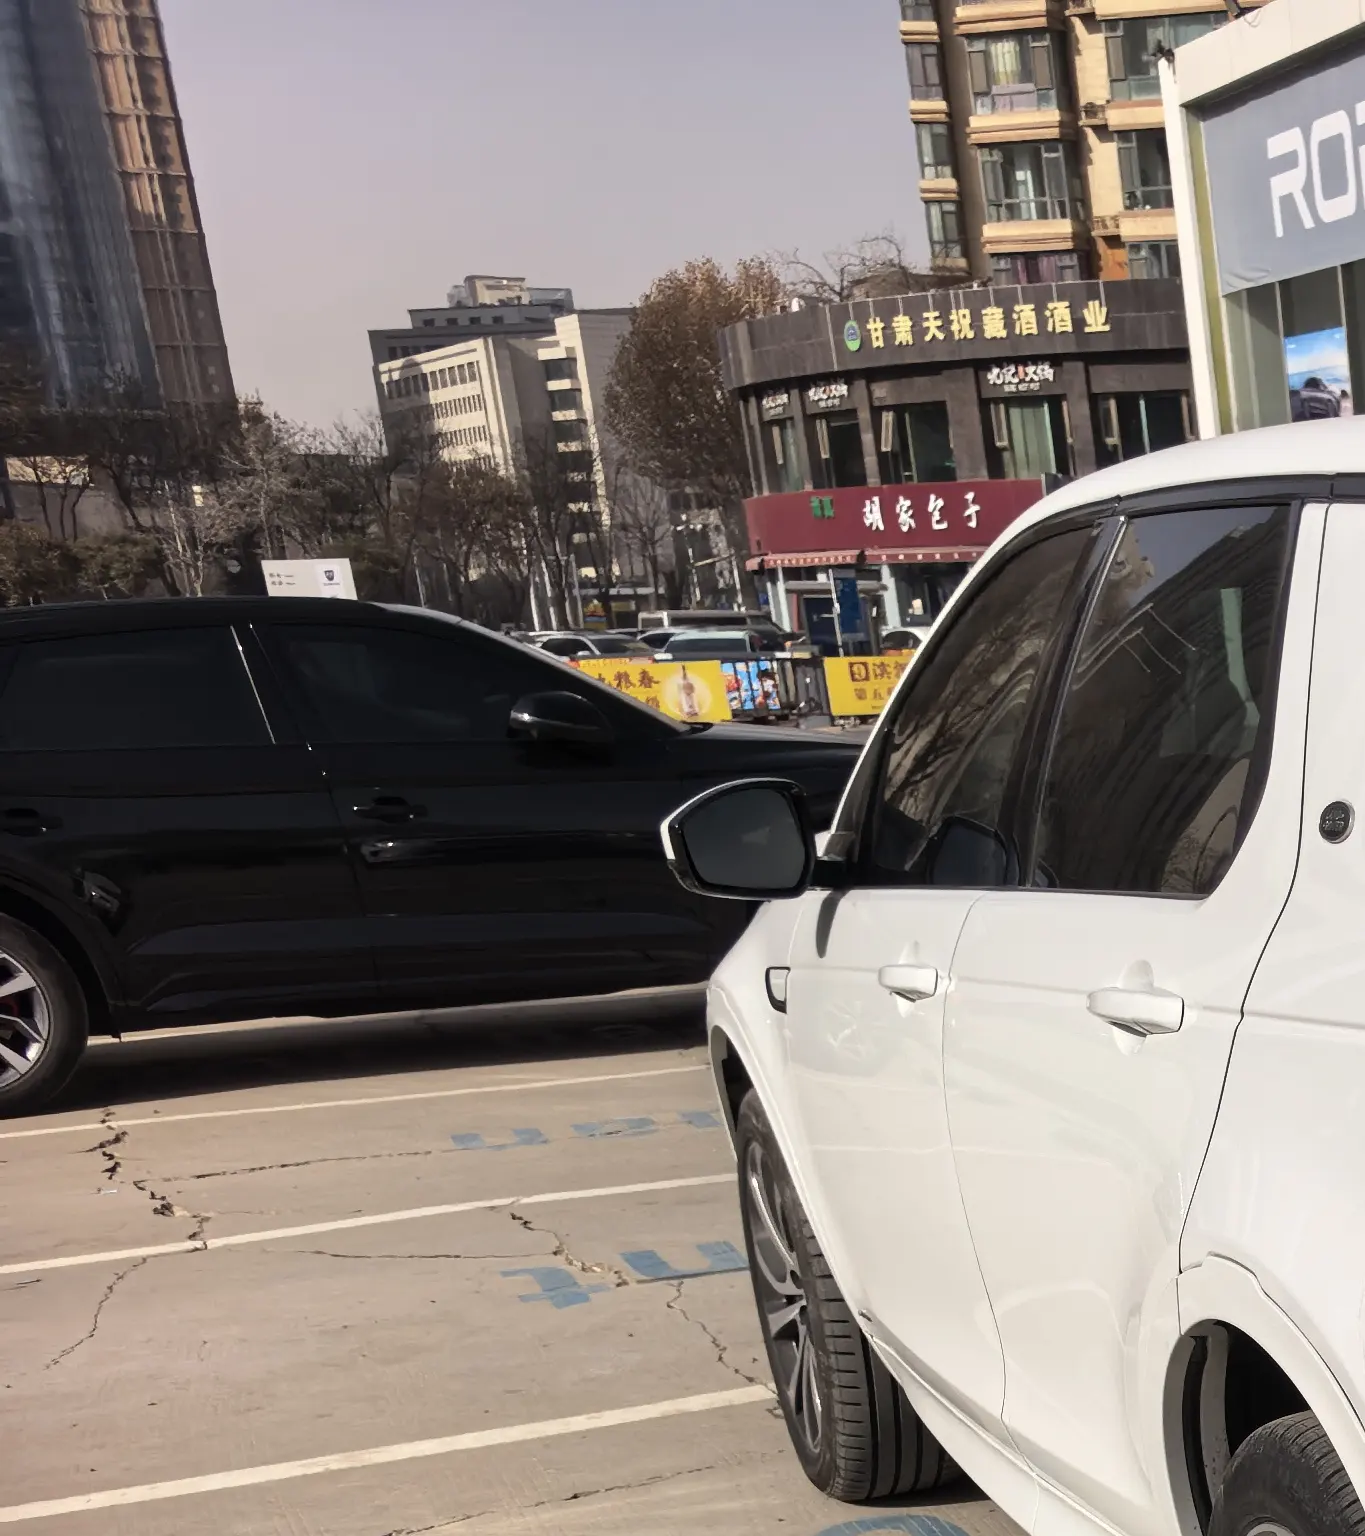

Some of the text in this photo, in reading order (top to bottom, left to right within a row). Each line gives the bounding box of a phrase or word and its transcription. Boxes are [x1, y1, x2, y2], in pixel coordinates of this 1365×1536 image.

[866, 301, 1111, 348] 甘肃天祝藏酒酒业
